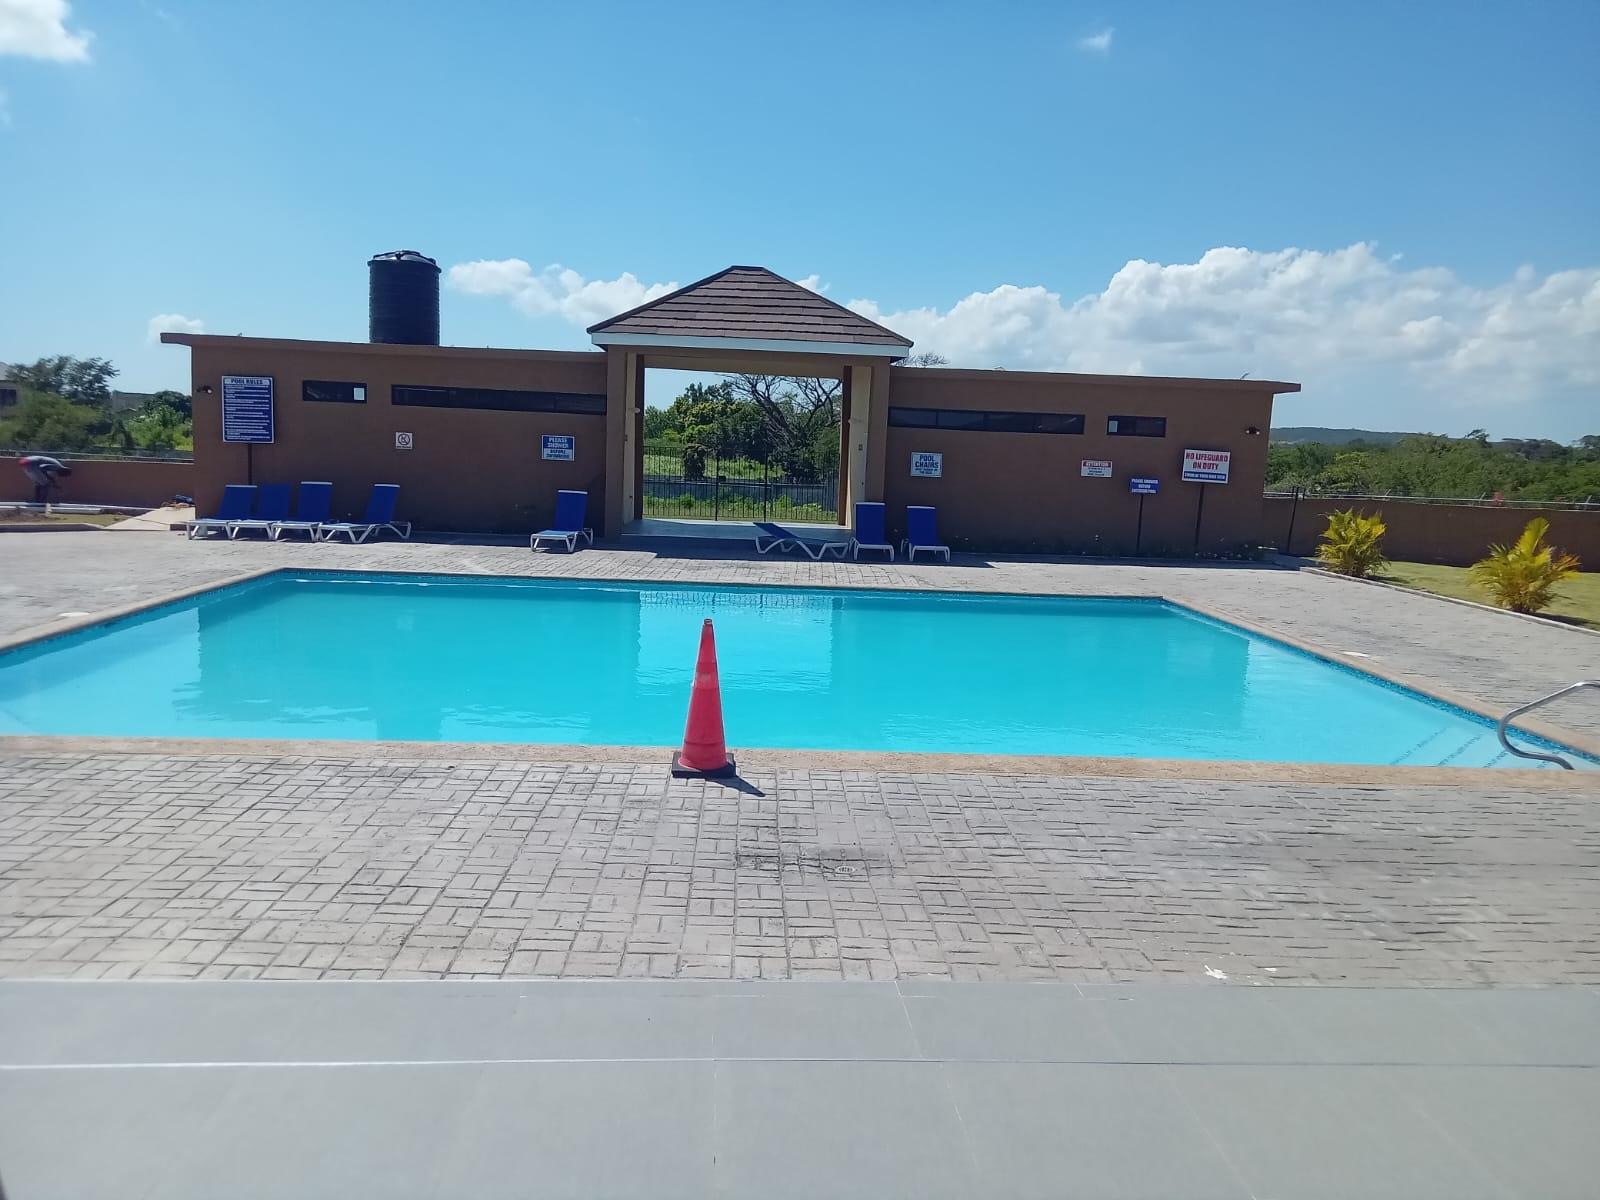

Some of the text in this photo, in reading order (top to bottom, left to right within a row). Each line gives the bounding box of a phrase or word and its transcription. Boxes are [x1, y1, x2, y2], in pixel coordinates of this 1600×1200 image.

[1186, 452, 1229, 462] NO LIFEGUARD
[915, 461, 939, 469] CHAIRS
[1192, 461, 1220, 470] ON DUTY
